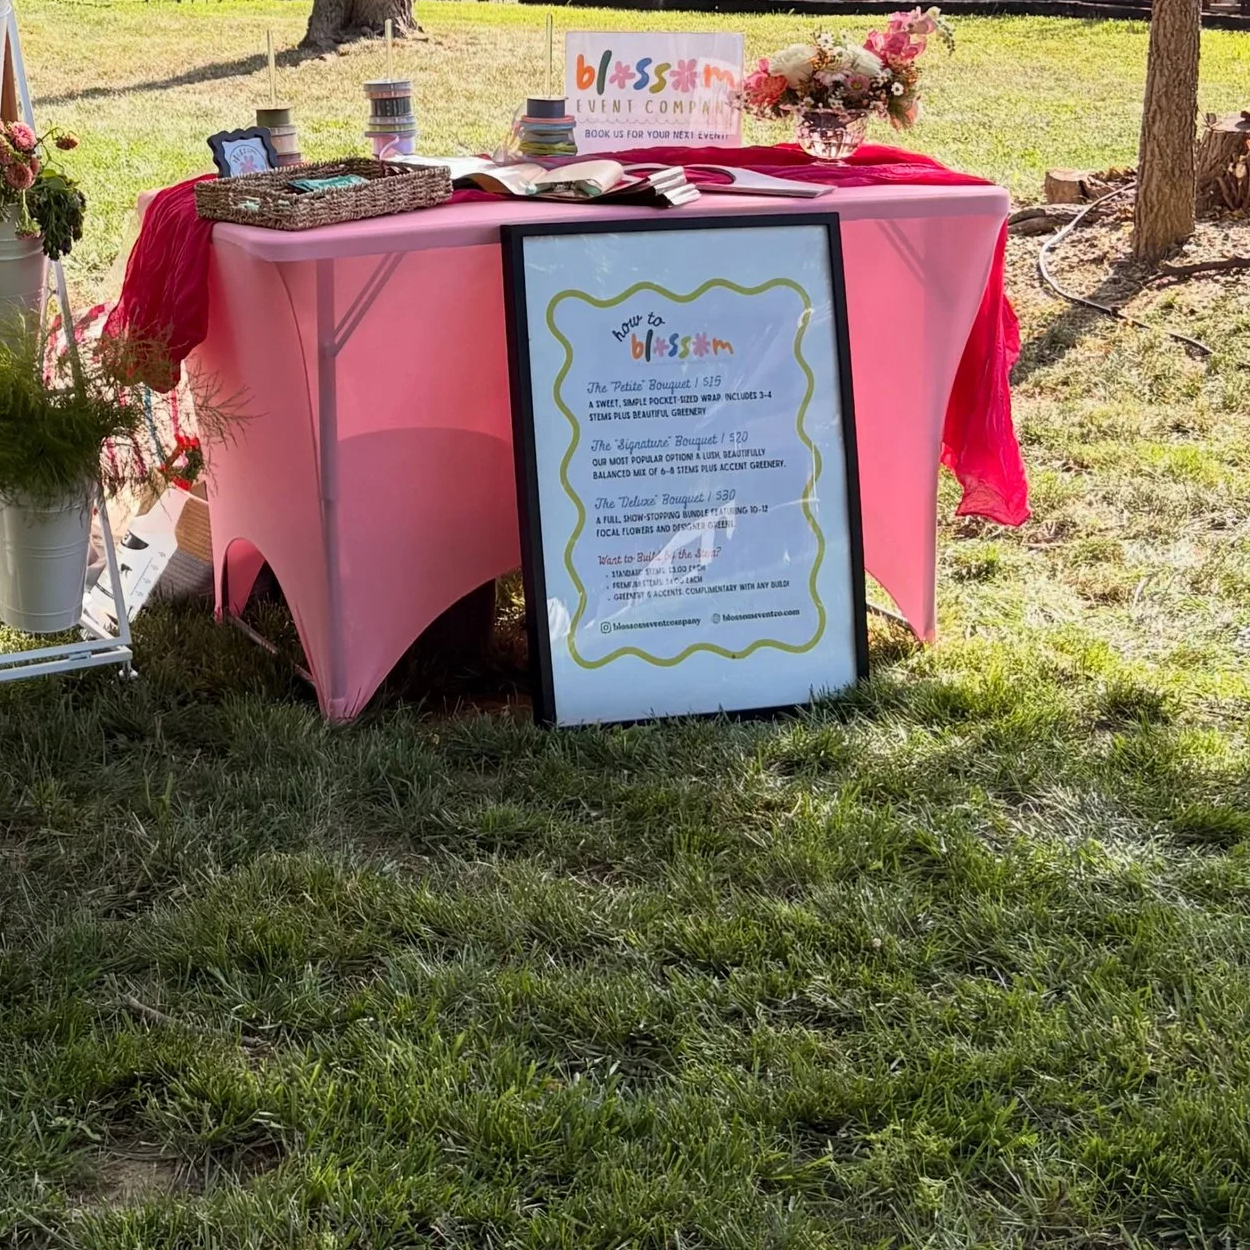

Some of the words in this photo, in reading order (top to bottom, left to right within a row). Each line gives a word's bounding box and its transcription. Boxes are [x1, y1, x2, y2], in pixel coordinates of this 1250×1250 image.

[576, 50, 736, 95] blossom
[576, 100, 632, 114] EVENT
[584, 129, 610, 139] BOOK
[614, 129, 624, 139] US
[627, 129, 644, 139] FOR
[647, 130, 670, 139] YOUR
[673, 130, 694, 140] NEXT
[611, 314, 643, 342] how
[647, 311, 666, 327] to
[631, 329, 734, 362] blossom
[587, 382, 608, 394] The
[649, 378, 691, 395] Bouquet
[703, 375, 722, 388] $15
[589, 401, 594, 409] A
[596, 399, 622, 409] SWEET,
[623, 397, 647, 407] SIMPLE
[649, 394, 699, 405] POCKET-SIZED
[725, 391, 757, 402] INCLUDES
[759, 391, 773, 400] 3-4
[589, 412, 612, 422] STEMS
[613, 411, 631, 420] PLUS
[632, 409, 669, 419] BEAUTIFUL
[591, 439, 612, 452] The
[675, 434, 718, 451] Bouquet
[729, 430, 749, 444] $20
[592, 458, 607, 467] OUR
[609, 456, 629, 466] MOST
[631, 454, 664, 464] POPULAR
[695, 452, 701, 460] A
[723, 447, 766, 459] BEAUTIFULLY
[593, 469, 631, 480] BALANCED
[633, 468, 647, 477] MIX
[648, 467, 658, 476] OF
[660, 466, 675, 475] 6-8
[676, 465, 699, 475] STEMS
[700, 463, 718, 473] PLUS
[719, 461, 748, 472] ACCENT
[594, 497, 616, 510] The
[662, 492, 704, 510] Bouquet
[716, 488, 736, 501] $30
[596, 517, 602, 525] A
[623, 510, 681, 523] SHOW-STOPPING
[682, 508, 708, 519] BUNDLE
[596, 528, 620, 538] FOCAL
[622, 525, 655, 537] FLOWERS
[656, 524, 671, 534] AND
[598, 554, 623, 566] Want
[623, 553, 635, 563] to
[677, 548, 693, 560] the
[685, 584, 738, 595] COMPLIMENTARY
[739, 582, 755, 591] WITH
[756, 581, 769, 590] ANY
[613, 617, 702, 632] blossomeventcompany
